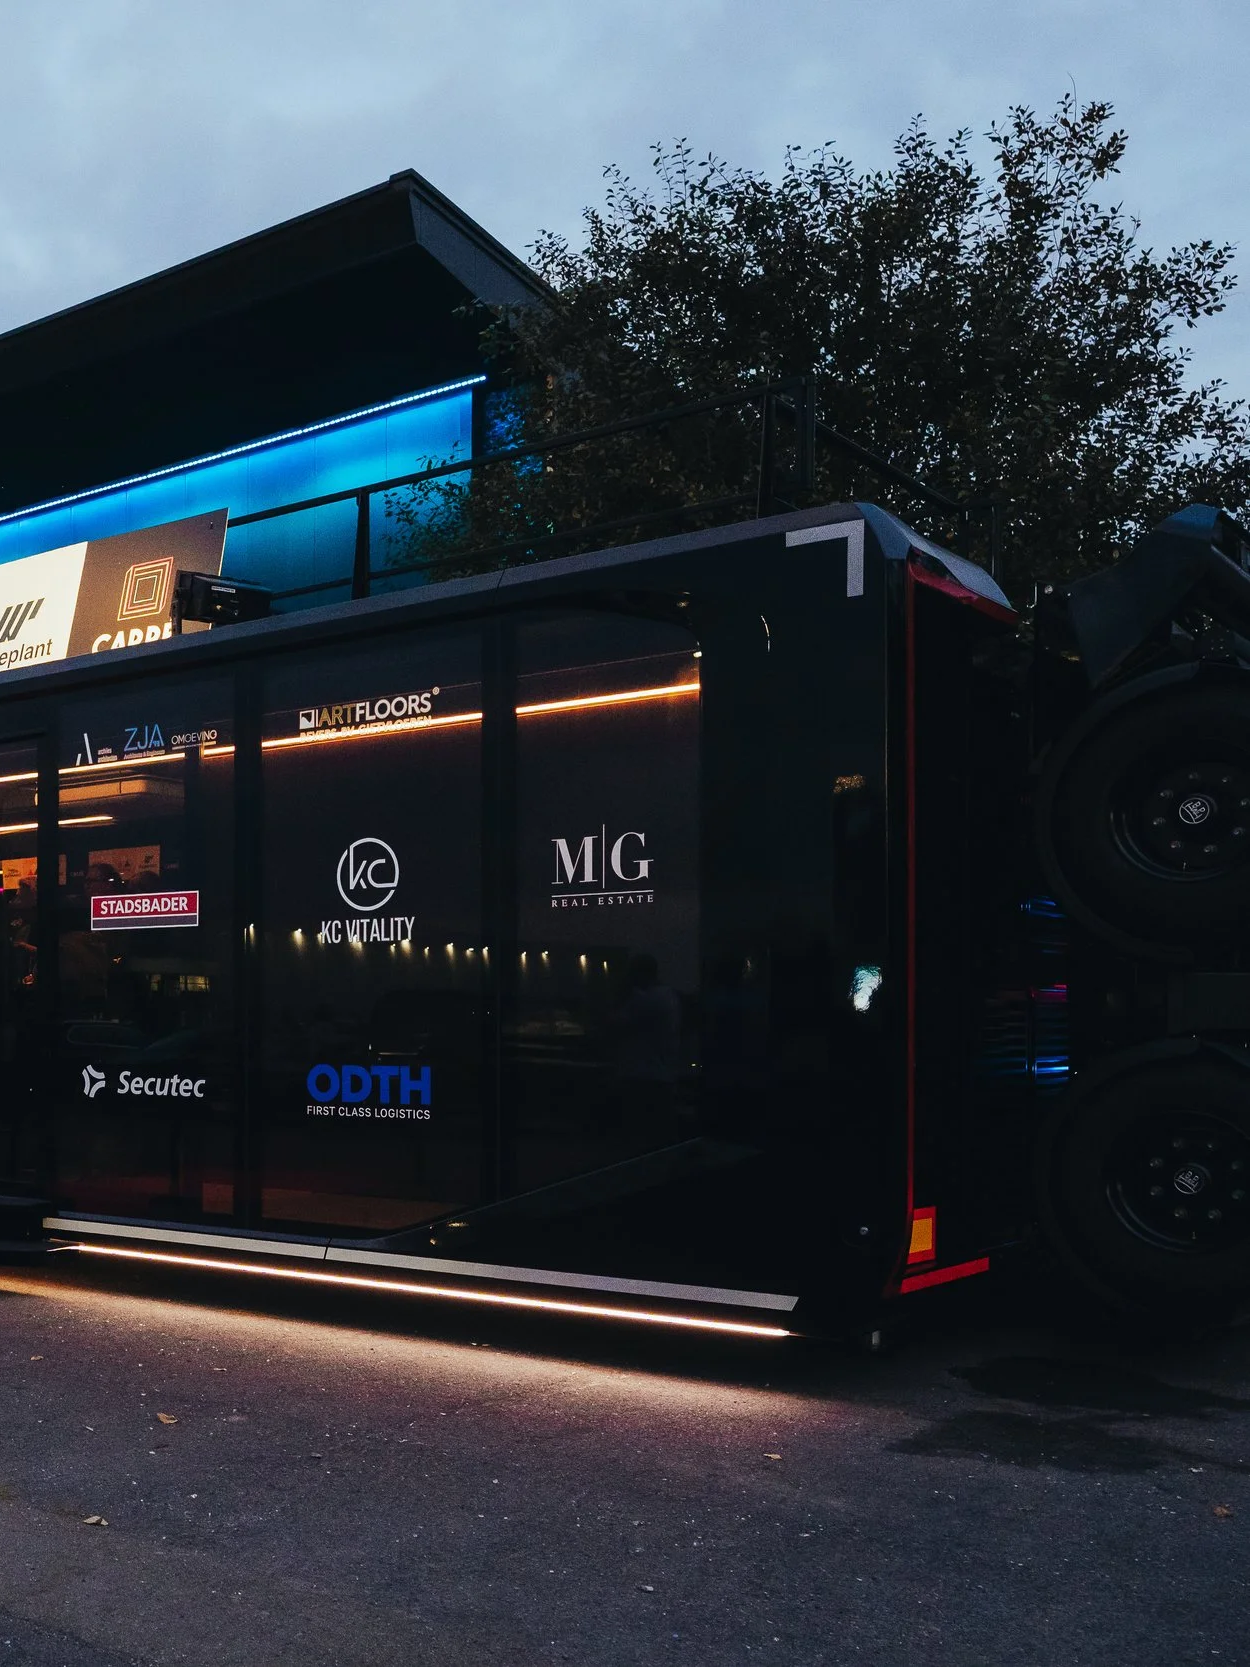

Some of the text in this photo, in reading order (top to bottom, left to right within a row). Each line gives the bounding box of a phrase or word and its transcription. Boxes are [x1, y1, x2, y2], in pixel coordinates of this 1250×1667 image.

[123, 722, 165, 753] ZJA
[100, 896, 189, 915] STADSBADER
[551, 894, 655, 908] REAL ESTATE
[321, 916, 416, 944] KC VITALITY
[116, 1070, 206, 1098] Secutec
[306, 1063, 432, 1105] ODTH
[306, 1105, 431, 1120] FIRST CLASS LOGISTICS
